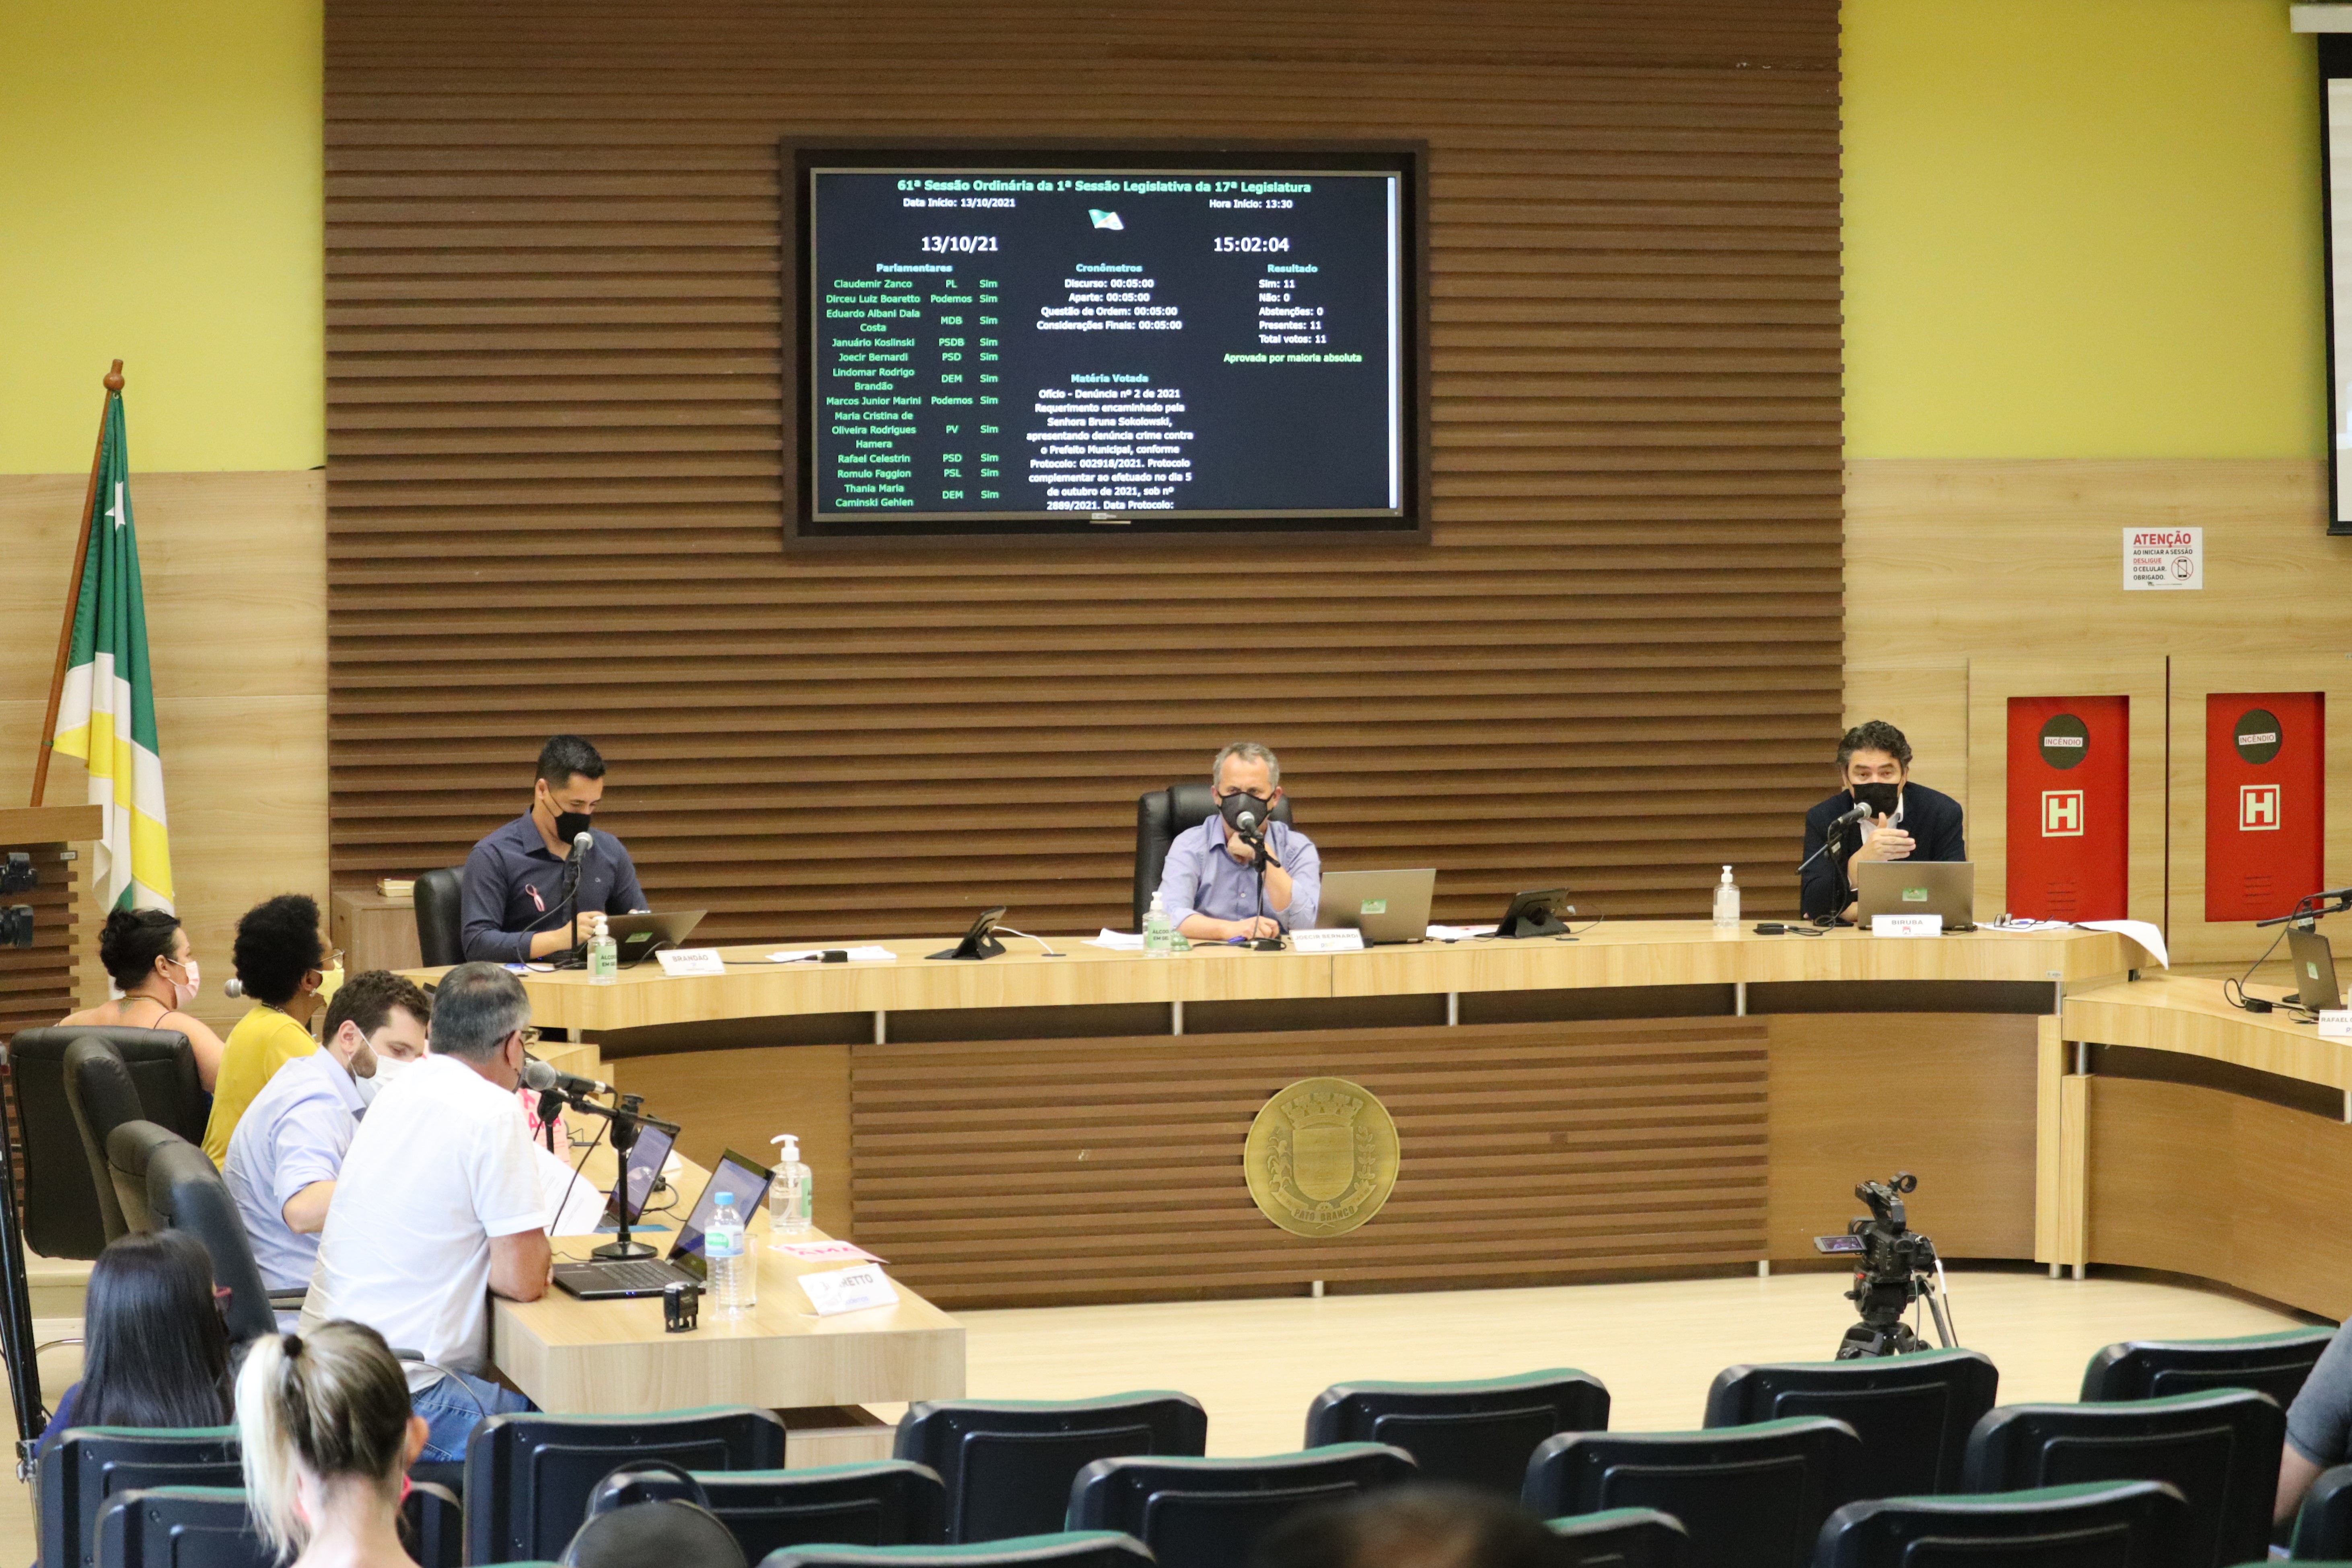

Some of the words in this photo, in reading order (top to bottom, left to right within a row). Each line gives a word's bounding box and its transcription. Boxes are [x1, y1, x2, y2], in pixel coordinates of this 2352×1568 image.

[924, 179, 971, 191] Sessão
[973, 179, 1034, 191] Ordinária
[1037, 180, 1054, 191] da
[1075, 180, 1121, 191] Sessão
[1124, 181, 1192, 194] Legislativa
[1195, 181, 1211, 192] da
[1241, 181, 1311, 195] Legislatura
[903, 197, 926, 207] Data
[928, 197, 957, 207] Início:
[961, 197, 1016, 208] 13/10/2021
[1209, 199, 1232, 208] Hora
[1233, 199, 1262, 208] Início:
[1266, 199, 1293, 209] 13:30
[922, 236, 998, 254] 13/10/21
[1214, 237, 1290, 252] 15:02:04
[876, 263, 953, 272] Parlamentares
[1076, 263, 1143, 272] Cronômetros
[1268, 264, 1318, 273] Resultado
[834, 279, 882, 288] Claudemir
[884, 279, 913, 288] Zanco
[946, 279, 957, 288] PL
[979, 279, 998, 288] Sim
[1064, 279, 1108, 288] Discurso:
[1110, 279, 1154, 288] 00:05:00
[1259, 279, 1280, 288] Sim:
[1284, 279, 1295, 288] 11
[826, 295, 856, 303] Dirceu
[859, 295, 878, 303] Luiz
[881, 294, 921, 303] Boaretto
[930, 294, 973, 303] Podemos
[1068, 293, 1103, 304] Aparte:
[1106, 292, 1150, 302] 00:05:00
[1259, 292, 1281, 302] Não:
[1283, 293, 1291, 302] 0
[826, 309, 865, 318] Eduardo
[867, 309, 897, 318] Albani
[899, 309, 920, 318] Dala
[1041, 306, 1081, 318] Questão
[1081, 306, 1095, 316] de
[1096, 306, 1132, 316] Ordem:
[1134, 306, 1178, 316] 00:05:00
[1258, 306, 1314, 318] Abstenções:
[1316, 307, 1324, 316] 0
[940, 316, 963, 325] MDB
[860, 323, 887, 332] Costa
[1036, 320, 1104, 331] Considerações
[1105, 320, 1136, 330] Finais:
[1138, 320, 1183, 330] 00:05:00
[1259, 321, 1307, 330] Presentes:
[1310, 321, 1322, 330] 11
[832, 338, 872, 347] Januário
[874, 338, 915, 347] Koslinski
[939, 338, 965, 346] PSDB
[1258, 334, 1282, 343] Total
[1283, 335, 1312, 343] votos:
[1315, 334, 1327, 343] 11
[838, 353, 866, 362] Joecir
[868, 353, 908, 362] Bernardi
[942, 352, 961, 361] PSD
[1223, 353, 1267, 364] Aprovada
[1269, 355, 1285, 364] por
[1287, 353, 1321, 362] maioria
[1323, 353, 1362, 362] absoluta
[833, 368, 877, 376] Lindomar
[879, 368, 915, 378] Rodrigo
[941, 374, 963, 383] DEM
[1071, 373, 1111, 383] Matéria
[1112, 374, 1149, 382] Votada
[854, 382, 893, 390] Brandão
[1038, 388, 1066, 399] Ofício
[1075, 388, 1119, 399] Denúncia
[1134, 389, 1141, 398] 2
[1142, 388, 1156, 398] de
[1157, 389, 1181, 398] 2021
[826, 397, 860, 405] Marcos
[861, 397, 890, 405] Junior
[893, 397, 921, 405] Marini
[931, 396, 973, 405] Podemos
[1035, 403, 1100, 414] Requerimento
[1101, 403, 1164, 412] encaminhado
[1165, 403, 1185, 414] pela
[835, 412, 860, 420] Maria
[863, 411, 899, 420] Cristina
[901, 411, 914, 420] de
[1047, 417, 1086, 427] Senhora
[1088, 417, 1117, 426] Bruna
[1118, 417, 1173, 427] Sokolowski,
[831, 426, 867, 434] Oliveira
[870, 425, 916, 436] Rodrigues
[1026, 431, 1091, 442] apresentando
[1091, 430, 1134, 440] denúncia
[1135, 431, 1163, 440] crime
[1163, 431, 1194, 440] contra
[856, 440, 893, 448] Hamera
[1040, 446, 1048, 454] o
[1049, 445, 1086, 454] Prefeito
[1087, 444, 1134, 456] Municipal,
[1136, 444, 1180, 454] conforme
[838, 454, 867, 463] Rafael
[869, 454, 910, 463] Celestrin
[942, 454, 962, 462] PSD
[1030, 459, 1077, 469] Protocolo:
[1079, 458, 1145, 469] 002918/2021.
[1147, 458, 1191, 468] Protocolo
[838, 469, 873, 478] Romulo
[875, 469, 911, 479] Faggion
[844, 484, 876, 493] Thania
[879, 484, 905, 492] Maria
[942, 490, 963, 499] DEM
[835, 498, 878, 507] Caminski
[881, 498, 914, 506] Gehlen
[1047, 500, 1101, 511] 2889/2021.
[1103, 500, 1126, 510] Data
[1128, 500, 1174, 510] Protocolo:
[2133, 530, 2191, 548] ATENÇÃO
[2045, 738, 2081, 746] INCÊNDIO
[2239, 734, 2275, 744] INCÊNDIO
[2246, 792, 2274, 824] H
[2048, 797, 2077, 830] H
[672, 953, 708, 962] BRANDÃO
[1294, 1208, 1315, 1221] PATO
[1320, 1205, 1355, 1222] BRANCO
